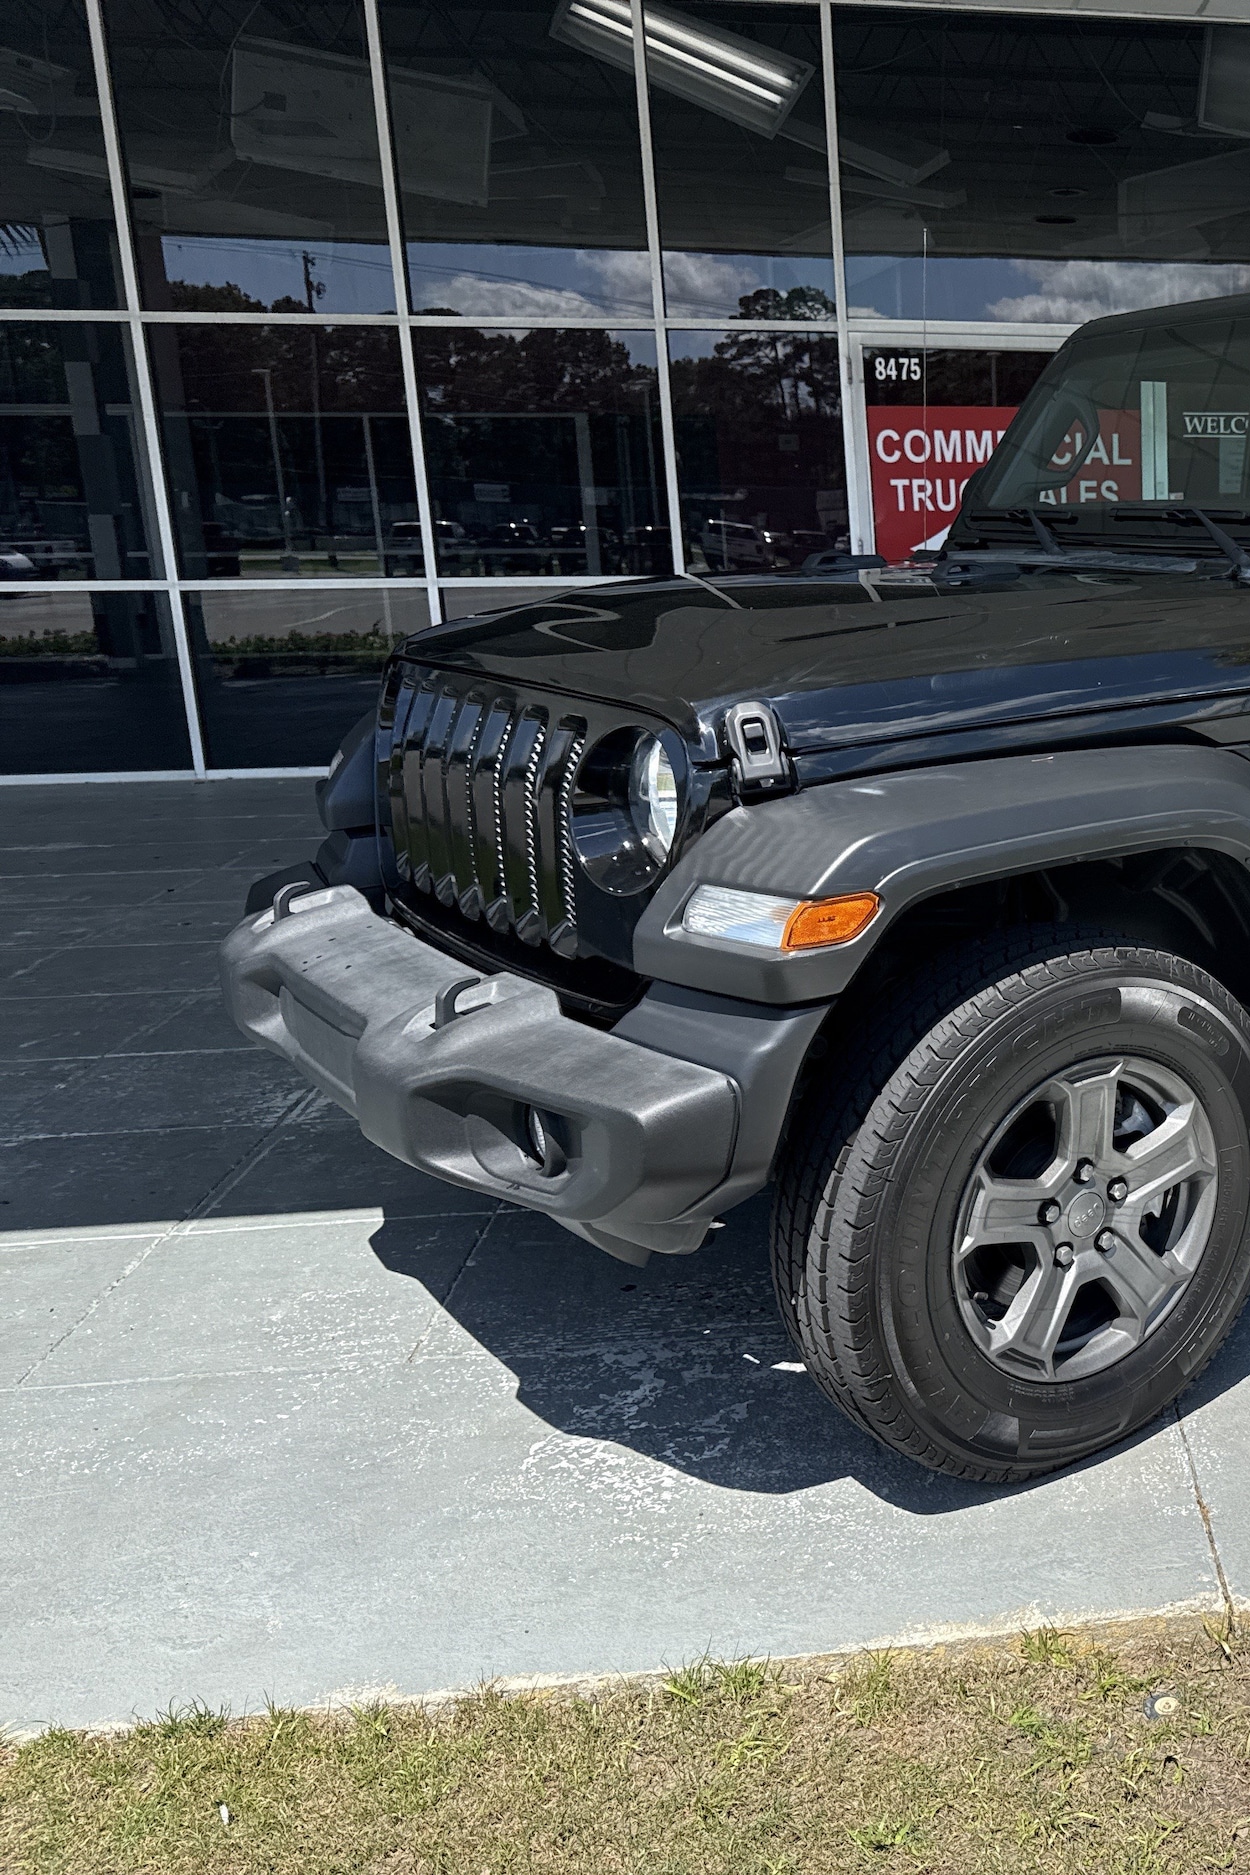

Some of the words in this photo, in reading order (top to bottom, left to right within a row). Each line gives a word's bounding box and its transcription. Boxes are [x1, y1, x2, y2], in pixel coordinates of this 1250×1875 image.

[874, 357, 922, 381] 8475
[1184, 415, 1249, 434] WELC
[890, 478, 972, 512] TRU
